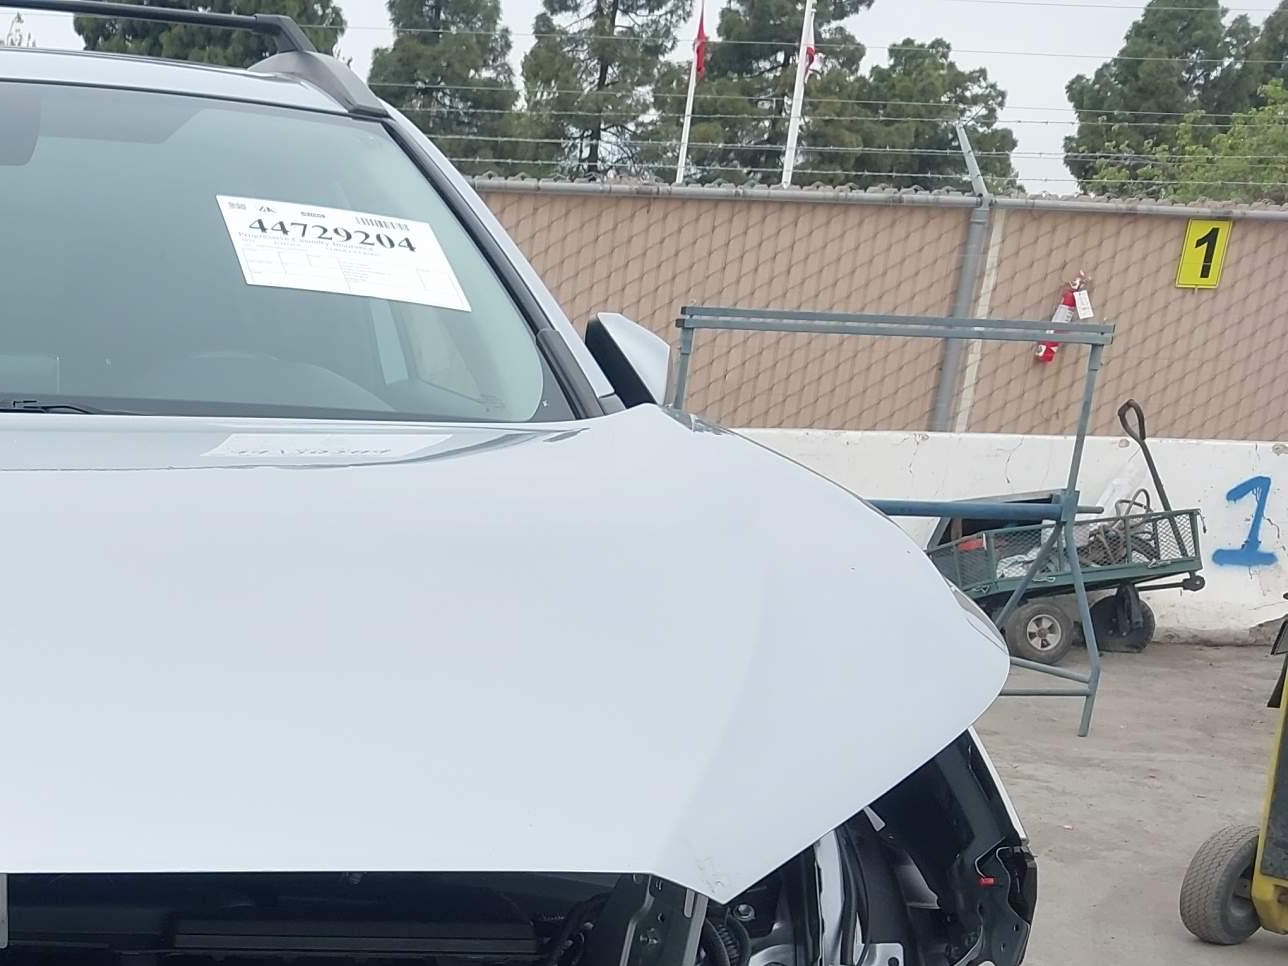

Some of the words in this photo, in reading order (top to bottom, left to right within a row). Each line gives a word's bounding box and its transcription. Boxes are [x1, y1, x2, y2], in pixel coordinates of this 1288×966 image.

[248, 218, 417, 252] 44729204
[1194, 226, 1220, 279] 1
[1211, 475, 1278, 566] 1
